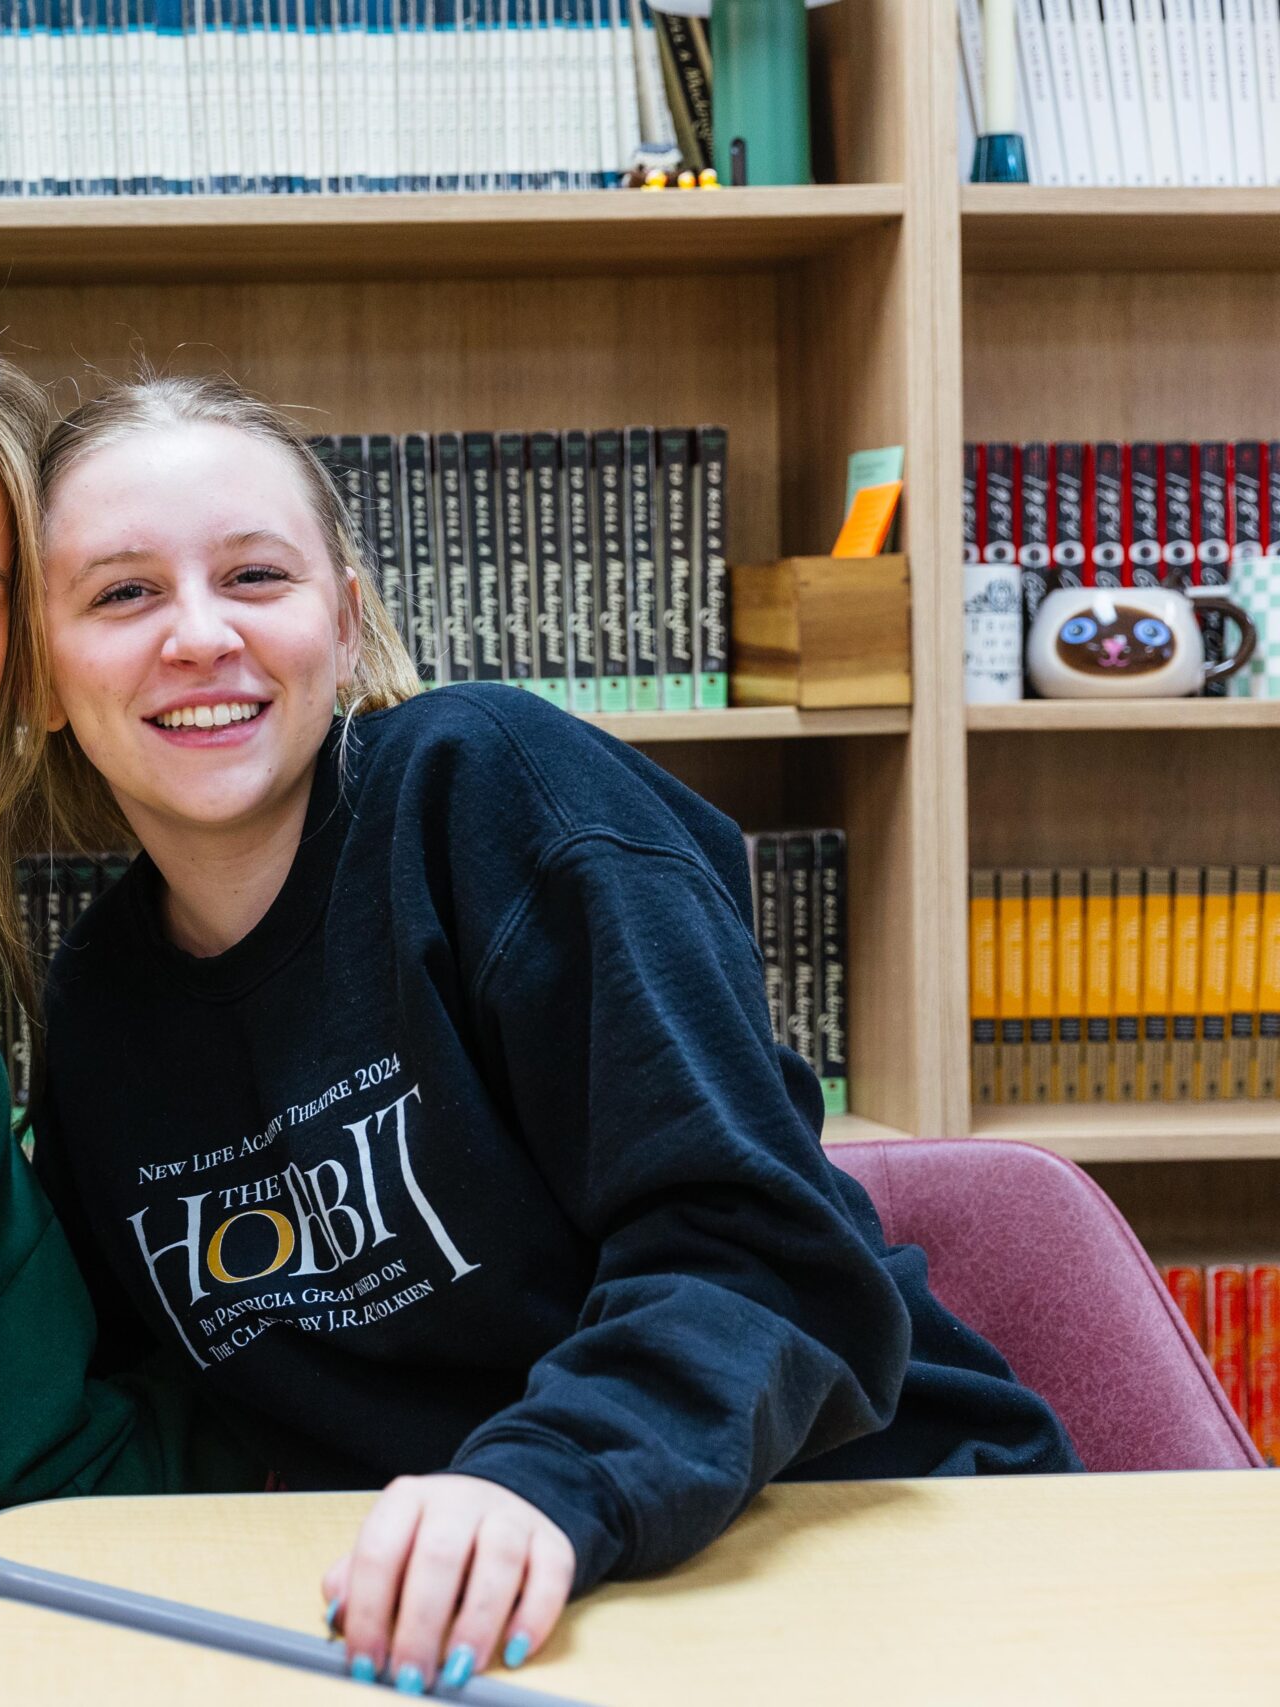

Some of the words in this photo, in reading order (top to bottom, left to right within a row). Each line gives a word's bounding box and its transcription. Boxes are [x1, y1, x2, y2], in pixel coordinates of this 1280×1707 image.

[507, 467, 522, 489] TO
[540, 467, 555, 489] TO
[571, 467, 586, 488] TO
[604, 466, 619, 487] TO
[633, 464, 649, 486] TO
[670, 463, 684, 485] TO
[707, 461, 721, 483] TO
[507, 494, 522, 537] KILL
[540, 493, 555, 536] KILL
[571, 493, 586, 535] KILL
[604, 492, 619, 534] KILL
[633, 491, 649, 532] KILL
[670, 489, 684, 532] KILL
[707, 488, 721, 531] KILL
[989, 472, 1014, 538] 1984
[1024, 474, 1048, 541] 1984
[1057, 473, 1082, 539] 1984
[1097, 474, 1122, 540] 1984
[1133, 472, 1159, 537] 1984
[1165, 471, 1190, 537] 1984
[1200, 470, 1225, 537] 1984
[1235, 472, 1260, 538] 1984
[507, 540, 522, 554] A
[540, 541, 555, 554] A
[571, 541, 586, 553] A
[604, 539, 619, 552] A
[633, 539, 649, 551] A
[670, 537, 684, 550] A
[707, 536, 721, 549] A
[505, 560, 531, 663] Mockingbird
[537, 559, 562, 664] Mockingbird
[568, 559, 594, 663] Mockingbird
[600, 558, 626, 662] Mockingbird
[629, 557, 657, 661] Mockingbird
[663, 556, 690, 660] Mockingbird
[699, 555, 726, 659] Mockingbird
[823, 868, 838, 890] TO
[823, 894, 838, 935] KILL
[823, 943, 838, 955] A
[817, 960, 844, 1063] Mockingbird
[138, 1160, 188, 1185] NEW
[193, 1146, 235, 1173] LIFE
[239, 1115, 283, 1158] ACAMY
[286, 1080, 352, 1126] THEATRE
[354, 1052, 401, 1091] 2024
[219, 1175, 282, 1210] THE
[126, 1083, 482, 1371] HOBBIT
[214, 1292, 296, 1327] PATRICIA
[301, 1288, 356, 1303] GRAY
[381, 1259, 408, 1282] ON
[208, 1341, 234, 1362] THE
[299, 1315, 322, 1332] BY
